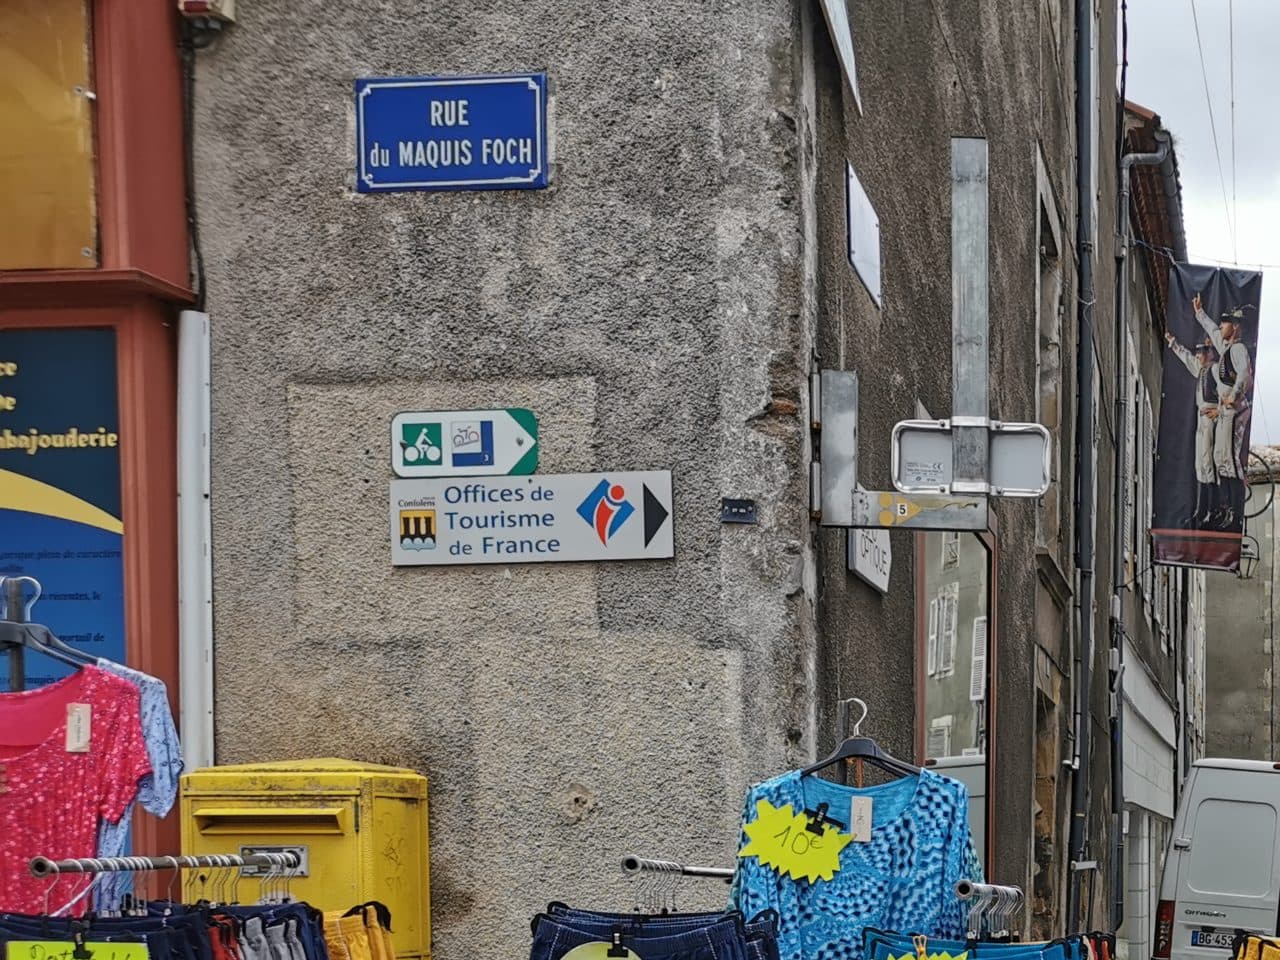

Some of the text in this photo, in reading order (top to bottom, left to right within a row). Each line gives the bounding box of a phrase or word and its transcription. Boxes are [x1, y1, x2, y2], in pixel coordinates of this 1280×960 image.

[431, 100, 469, 126] RUE
[370, 138, 531, 168] du MAQUIS FOCH
[444, 485, 554, 504] Offices de
[899, 504, 906, 515] 5
[444, 512, 555, 529] Tourisme
[449, 535, 561, 555] de France
